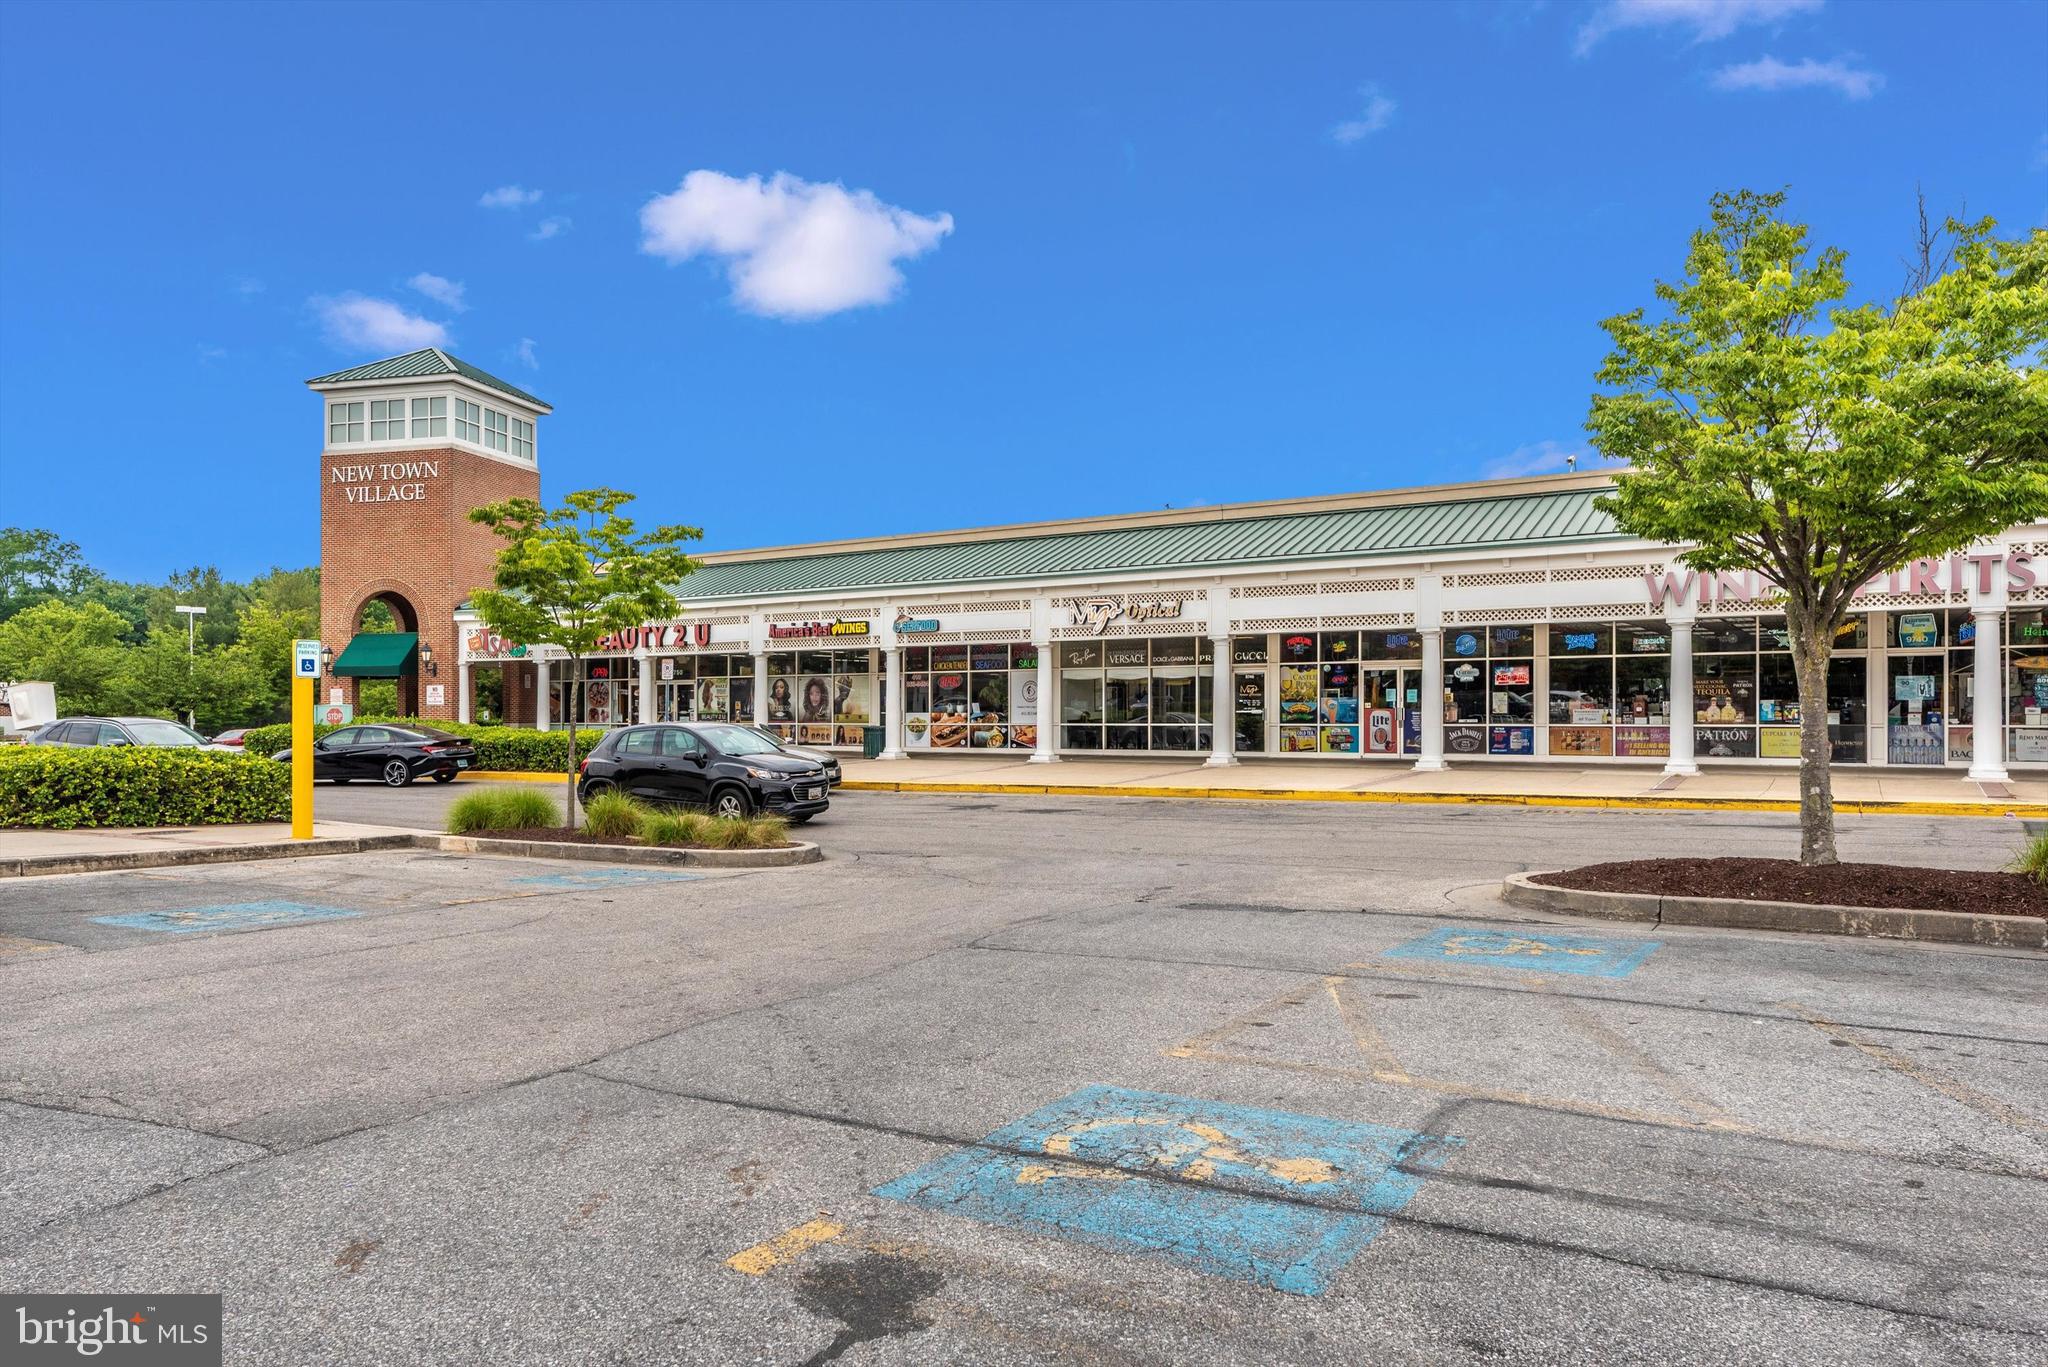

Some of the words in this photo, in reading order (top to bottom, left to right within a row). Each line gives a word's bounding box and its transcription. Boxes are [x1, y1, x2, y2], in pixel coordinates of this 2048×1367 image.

[332, 465, 375, 483] NEW
[379, 461, 438, 480] TOWN
[345, 484, 426, 503] VILLAGE
[838, 622, 867, 634] WINGS
[694, 623, 710, 647] U
[1109, 654, 1145, 664] VERSACE
[1235, 652, 1267, 660] GUCCI
[975, 660, 1006, 669] SEAFOOD
[327, 713, 342, 721] STOP
[1373, 715, 1390, 727] Lite
[1449, 730, 1462, 740] JACK
[1697, 729, 1748, 741] PATRÓN
